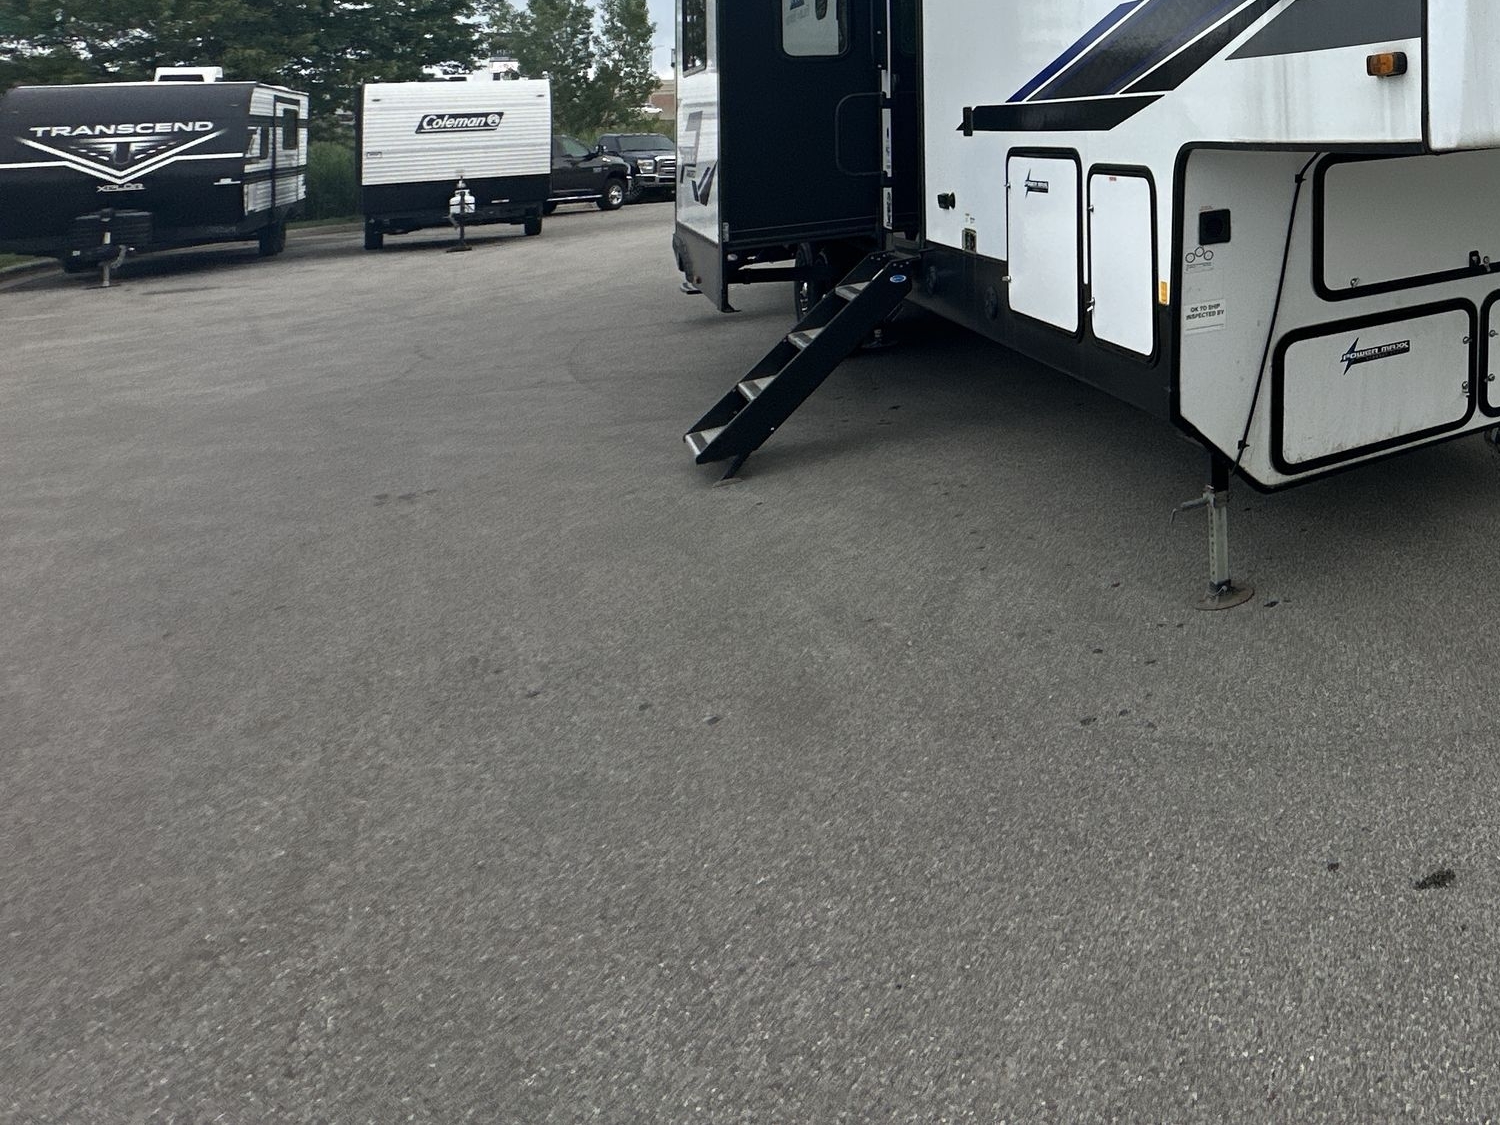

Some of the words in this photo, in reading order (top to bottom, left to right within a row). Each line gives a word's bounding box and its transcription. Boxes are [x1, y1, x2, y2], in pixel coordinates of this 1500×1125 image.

[29, 121, 214, 137] TRANSCEND
[422, 115, 486, 129] Coleman
[1343, 348, 1379, 361] POWER
[1381, 342, 1409, 353] MAXX
